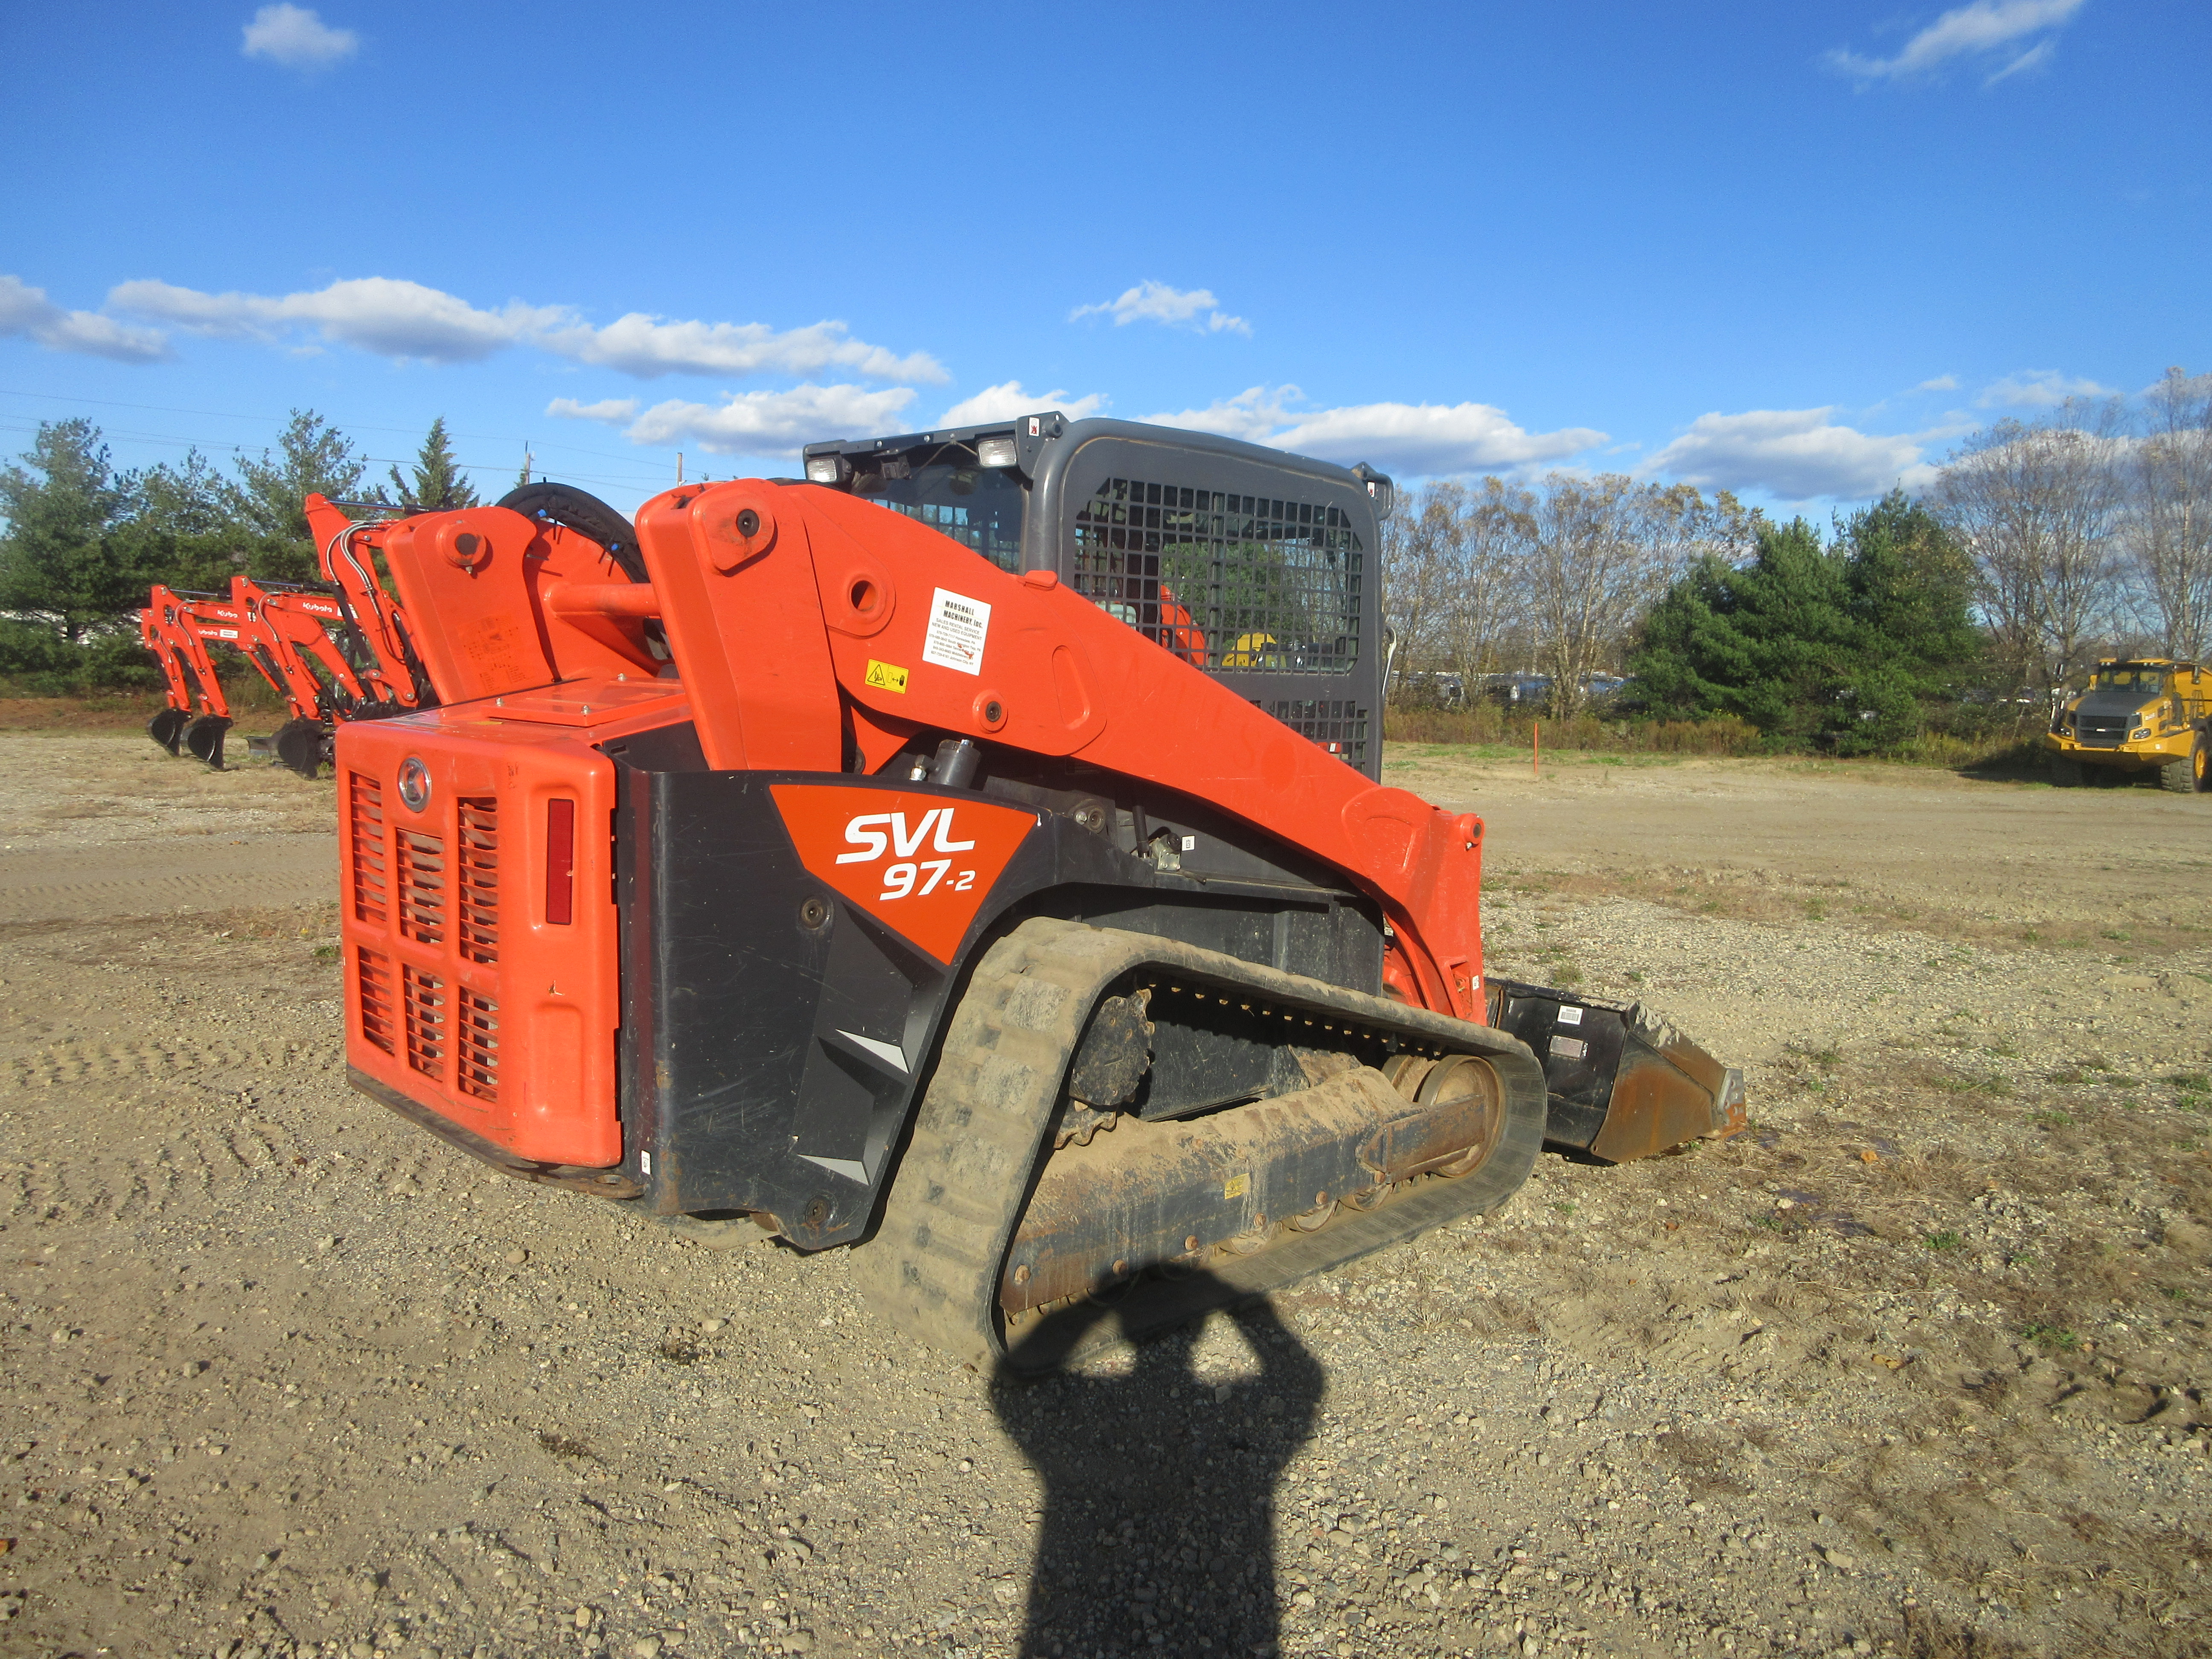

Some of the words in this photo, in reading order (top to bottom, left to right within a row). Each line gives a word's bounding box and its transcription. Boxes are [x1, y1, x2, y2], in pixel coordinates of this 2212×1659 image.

[303, 602, 332, 613] Kubota
[945, 600, 975, 615] MARSHALL
[943, 610, 973, 626] MACHINERY,
[973, 619, 984, 629] Inc.
[960, 631, 982, 640] EQUIPMENT
[964, 626, 980, 634] SERVICE
[835, 808, 975, 864] SVL
[879, 859, 976, 901] 97-2
